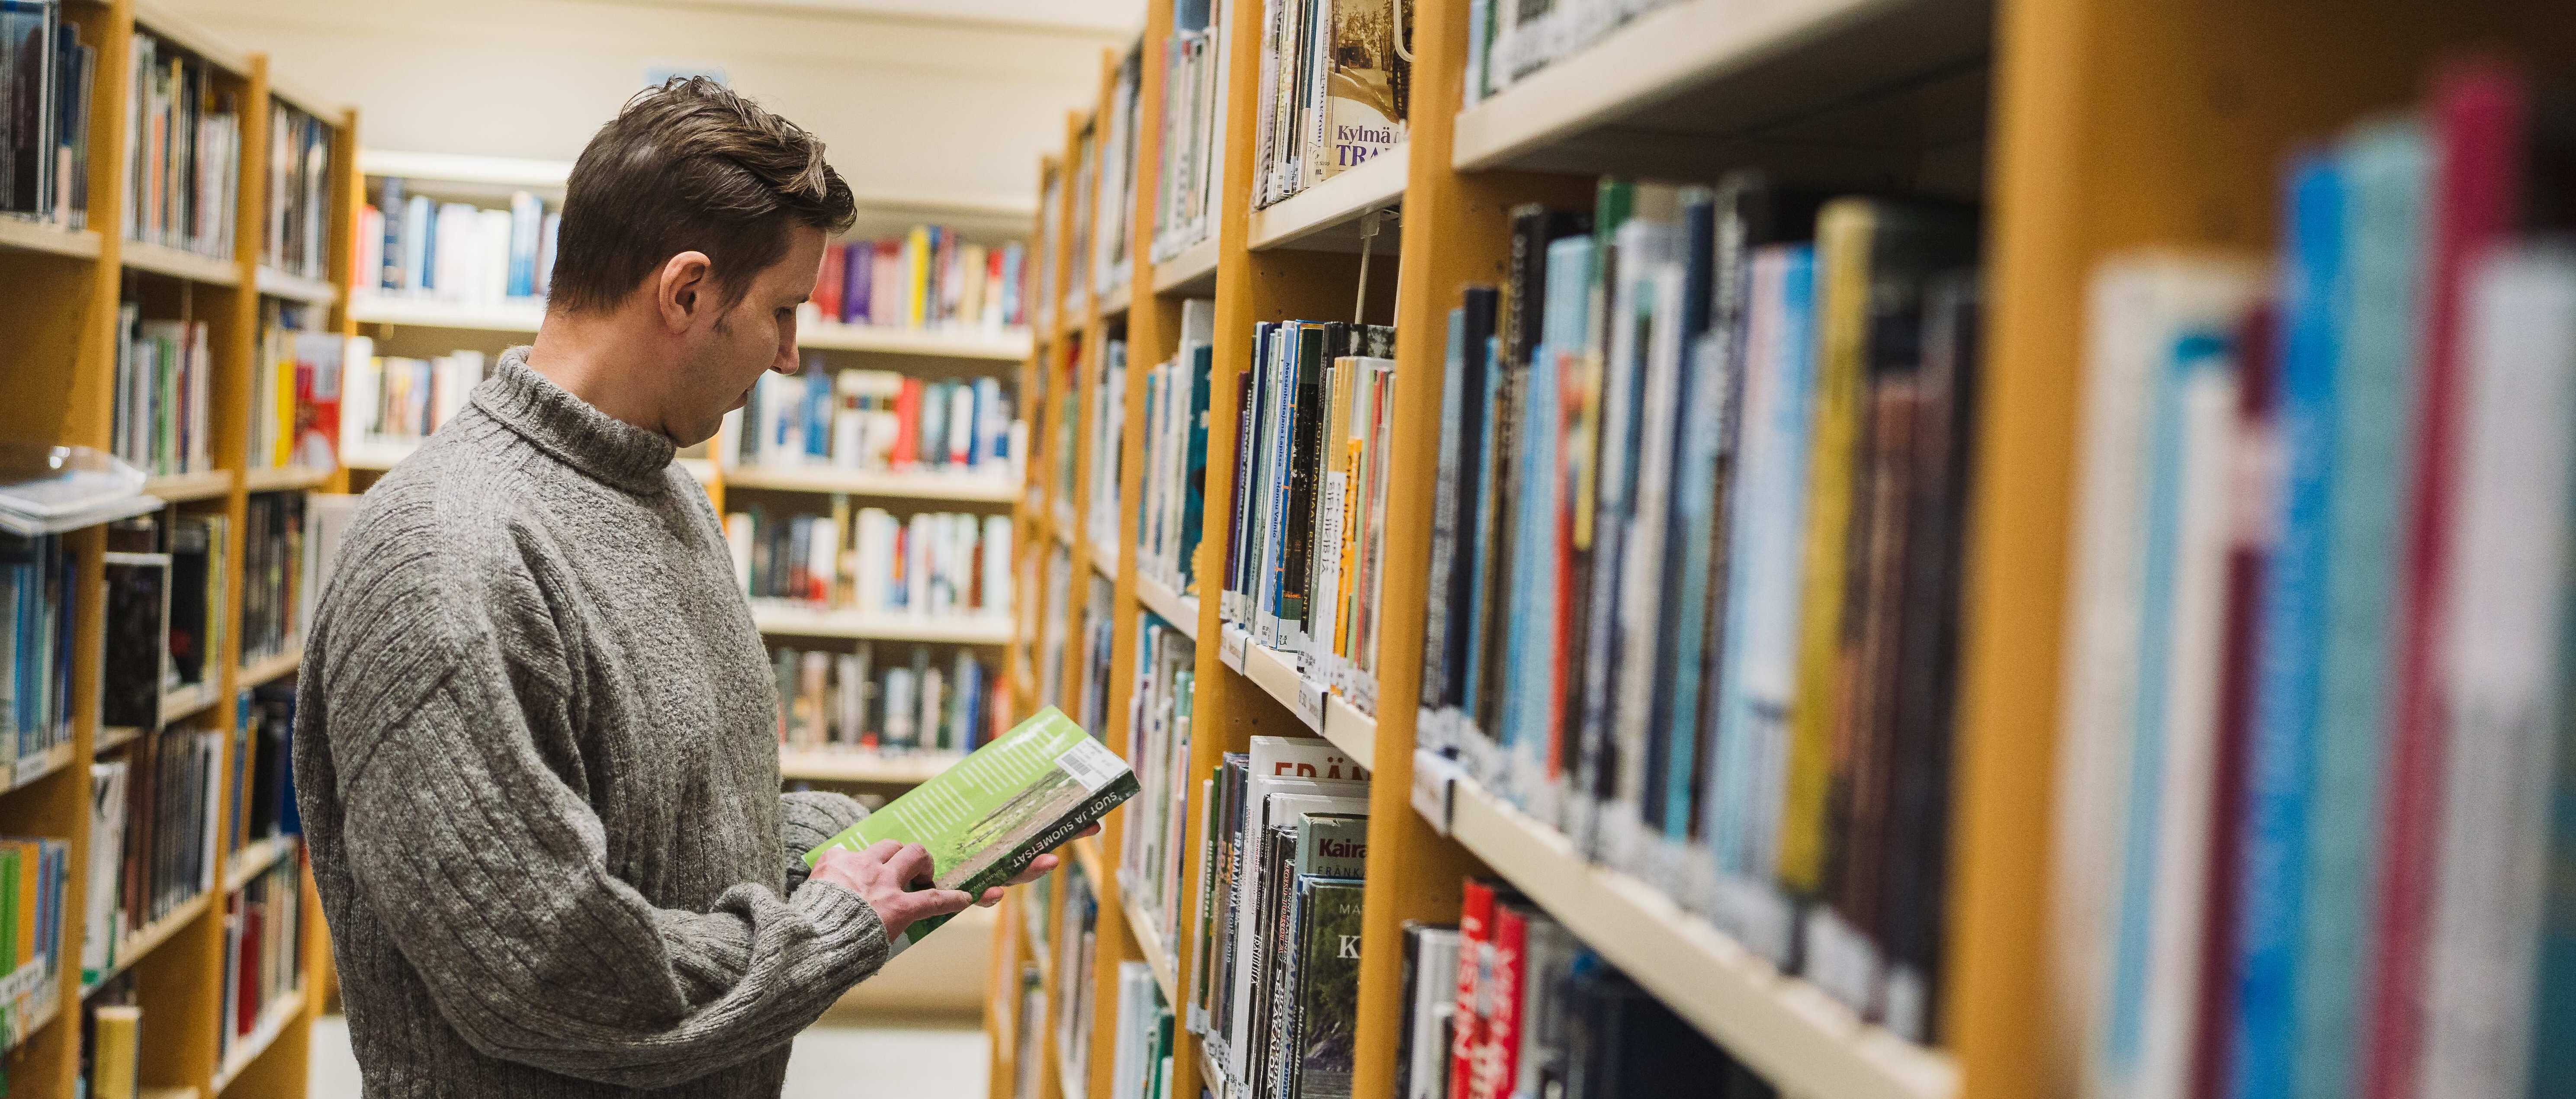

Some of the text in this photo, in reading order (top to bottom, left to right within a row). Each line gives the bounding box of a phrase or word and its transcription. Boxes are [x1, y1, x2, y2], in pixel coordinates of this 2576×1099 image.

[1337, 125, 1390, 145] Kylmä
[1280, 362, 1289, 434] Metsänhoitajana
[1302, 531, 1313, 621] RUOKASIENET
[1014, 791, 1118, 868] SUOT JA SUOMETSÄT
[1283, 916, 1291, 964] KAASINEN
[1267, 968, 1282, 1089] SEKAKALOJA
